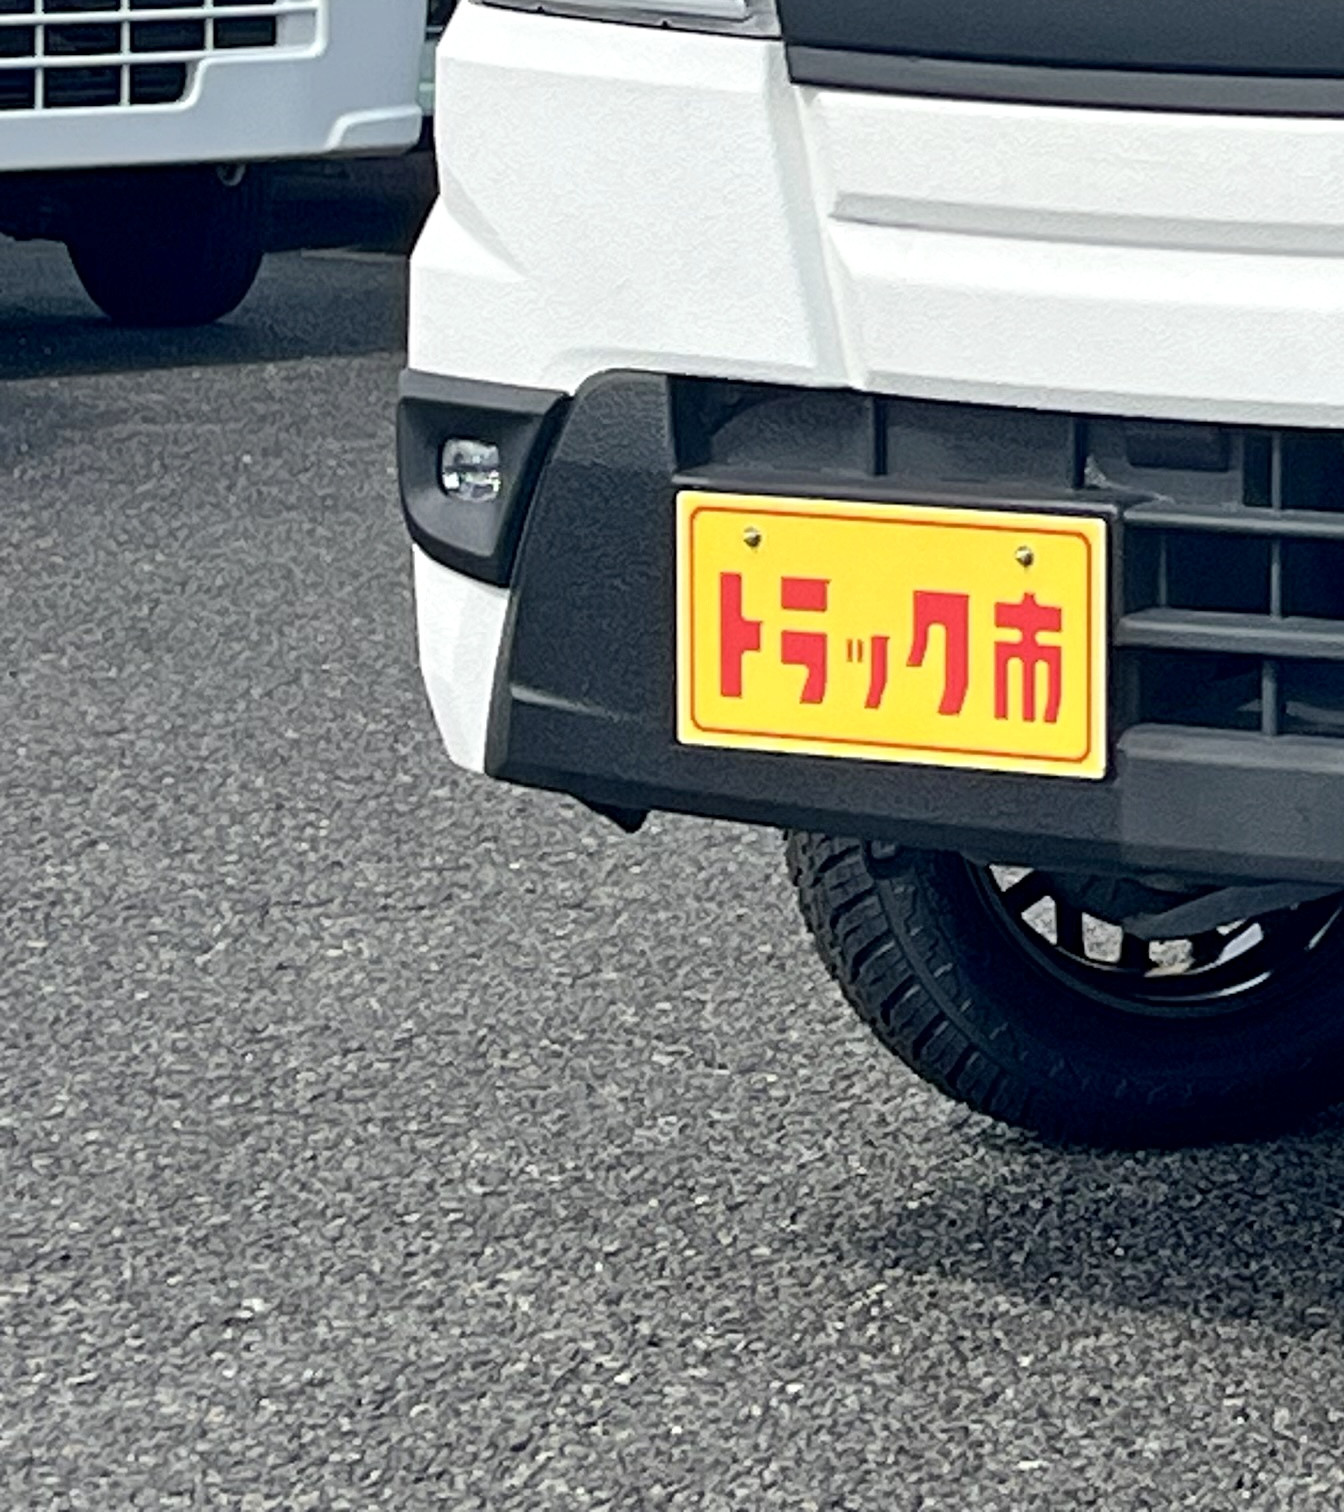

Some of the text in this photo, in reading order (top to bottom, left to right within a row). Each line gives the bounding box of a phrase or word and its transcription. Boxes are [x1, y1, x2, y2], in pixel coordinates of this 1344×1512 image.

[719, 571, 1063, 724] トラック市
